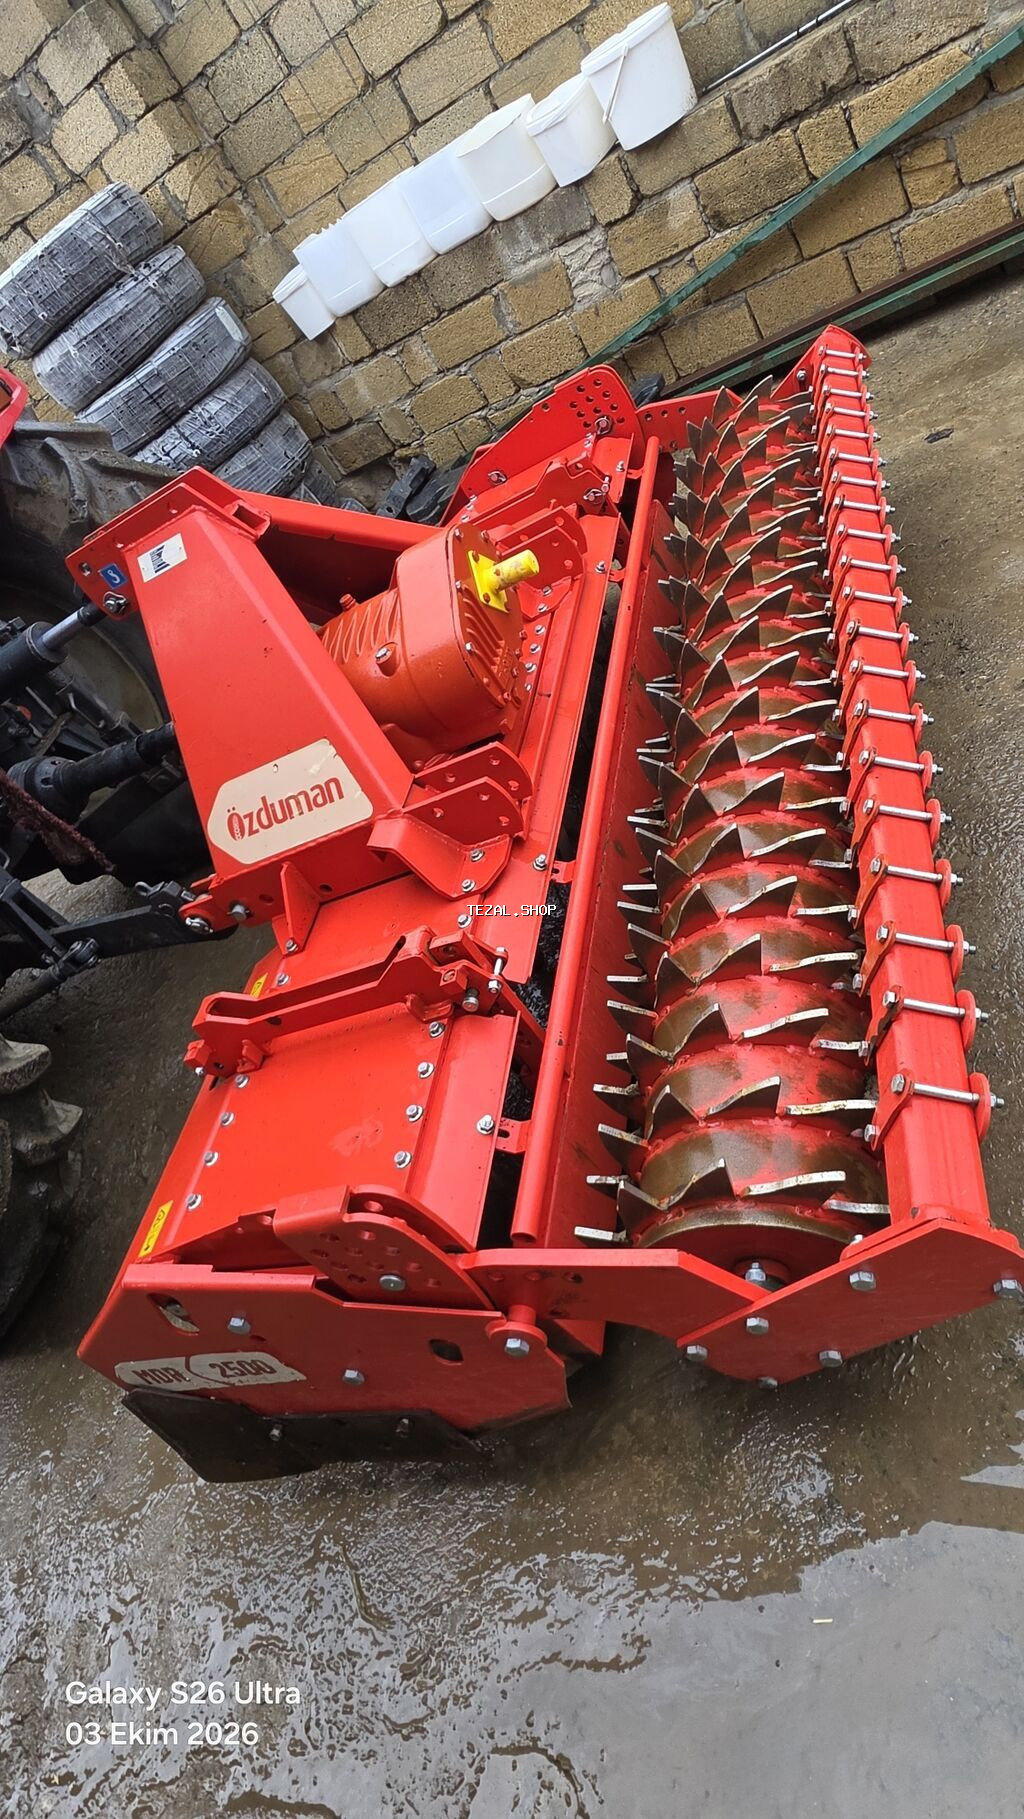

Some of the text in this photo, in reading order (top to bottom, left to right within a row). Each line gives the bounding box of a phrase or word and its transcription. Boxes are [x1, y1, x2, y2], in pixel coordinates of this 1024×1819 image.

[227, 777, 344, 841] Özduman
[132, 1359, 277, 1385] MDR 2500
